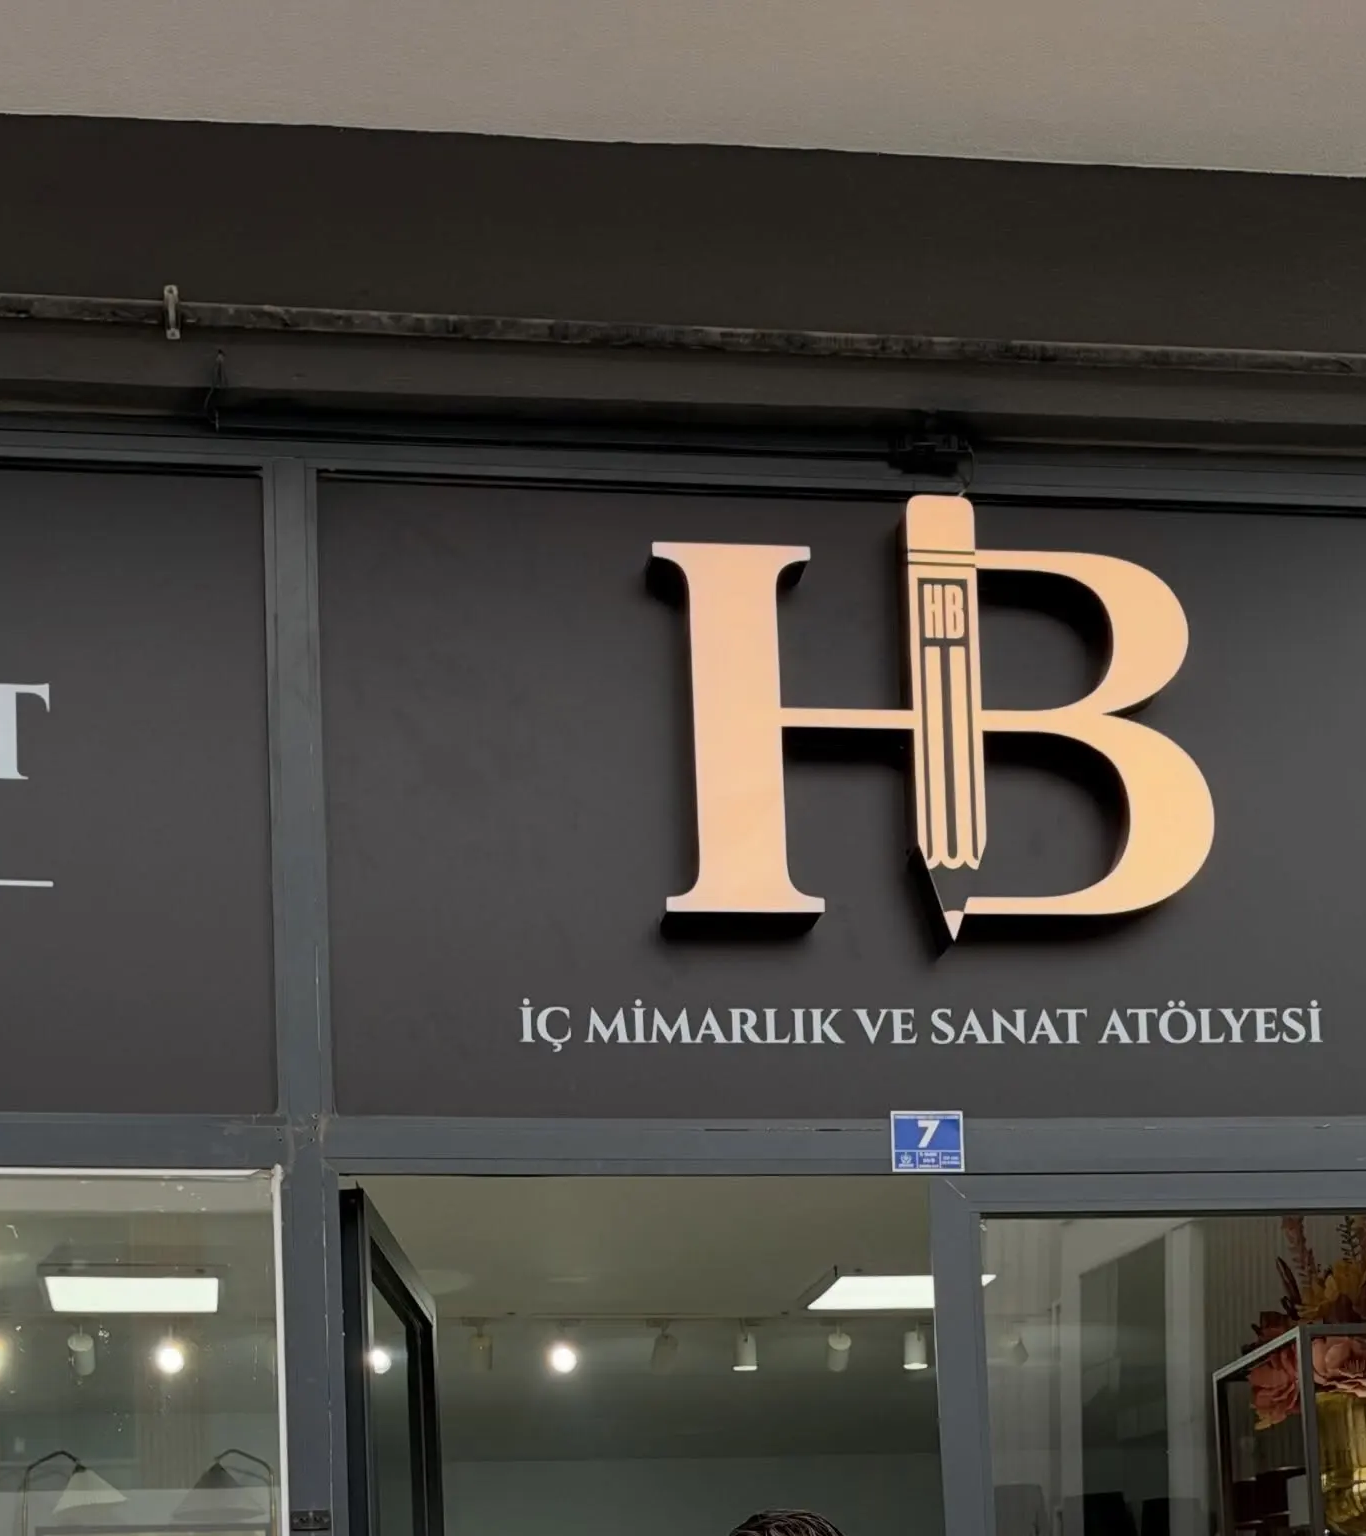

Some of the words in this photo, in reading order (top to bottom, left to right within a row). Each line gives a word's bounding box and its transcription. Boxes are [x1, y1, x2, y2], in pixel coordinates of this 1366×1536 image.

[922, 583, 966, 640] HB
[519, 998, 573, 1053] İÇ
[584, 998, 846, 1045] MİMARLIK
[852, 1007, 919, 1045] VE
[929, 1007, 1089, 1046] SANAT
[1097, 999, 1324, 1045] ATÖLYESİ
[917, 1119, 940, 1149] 7
